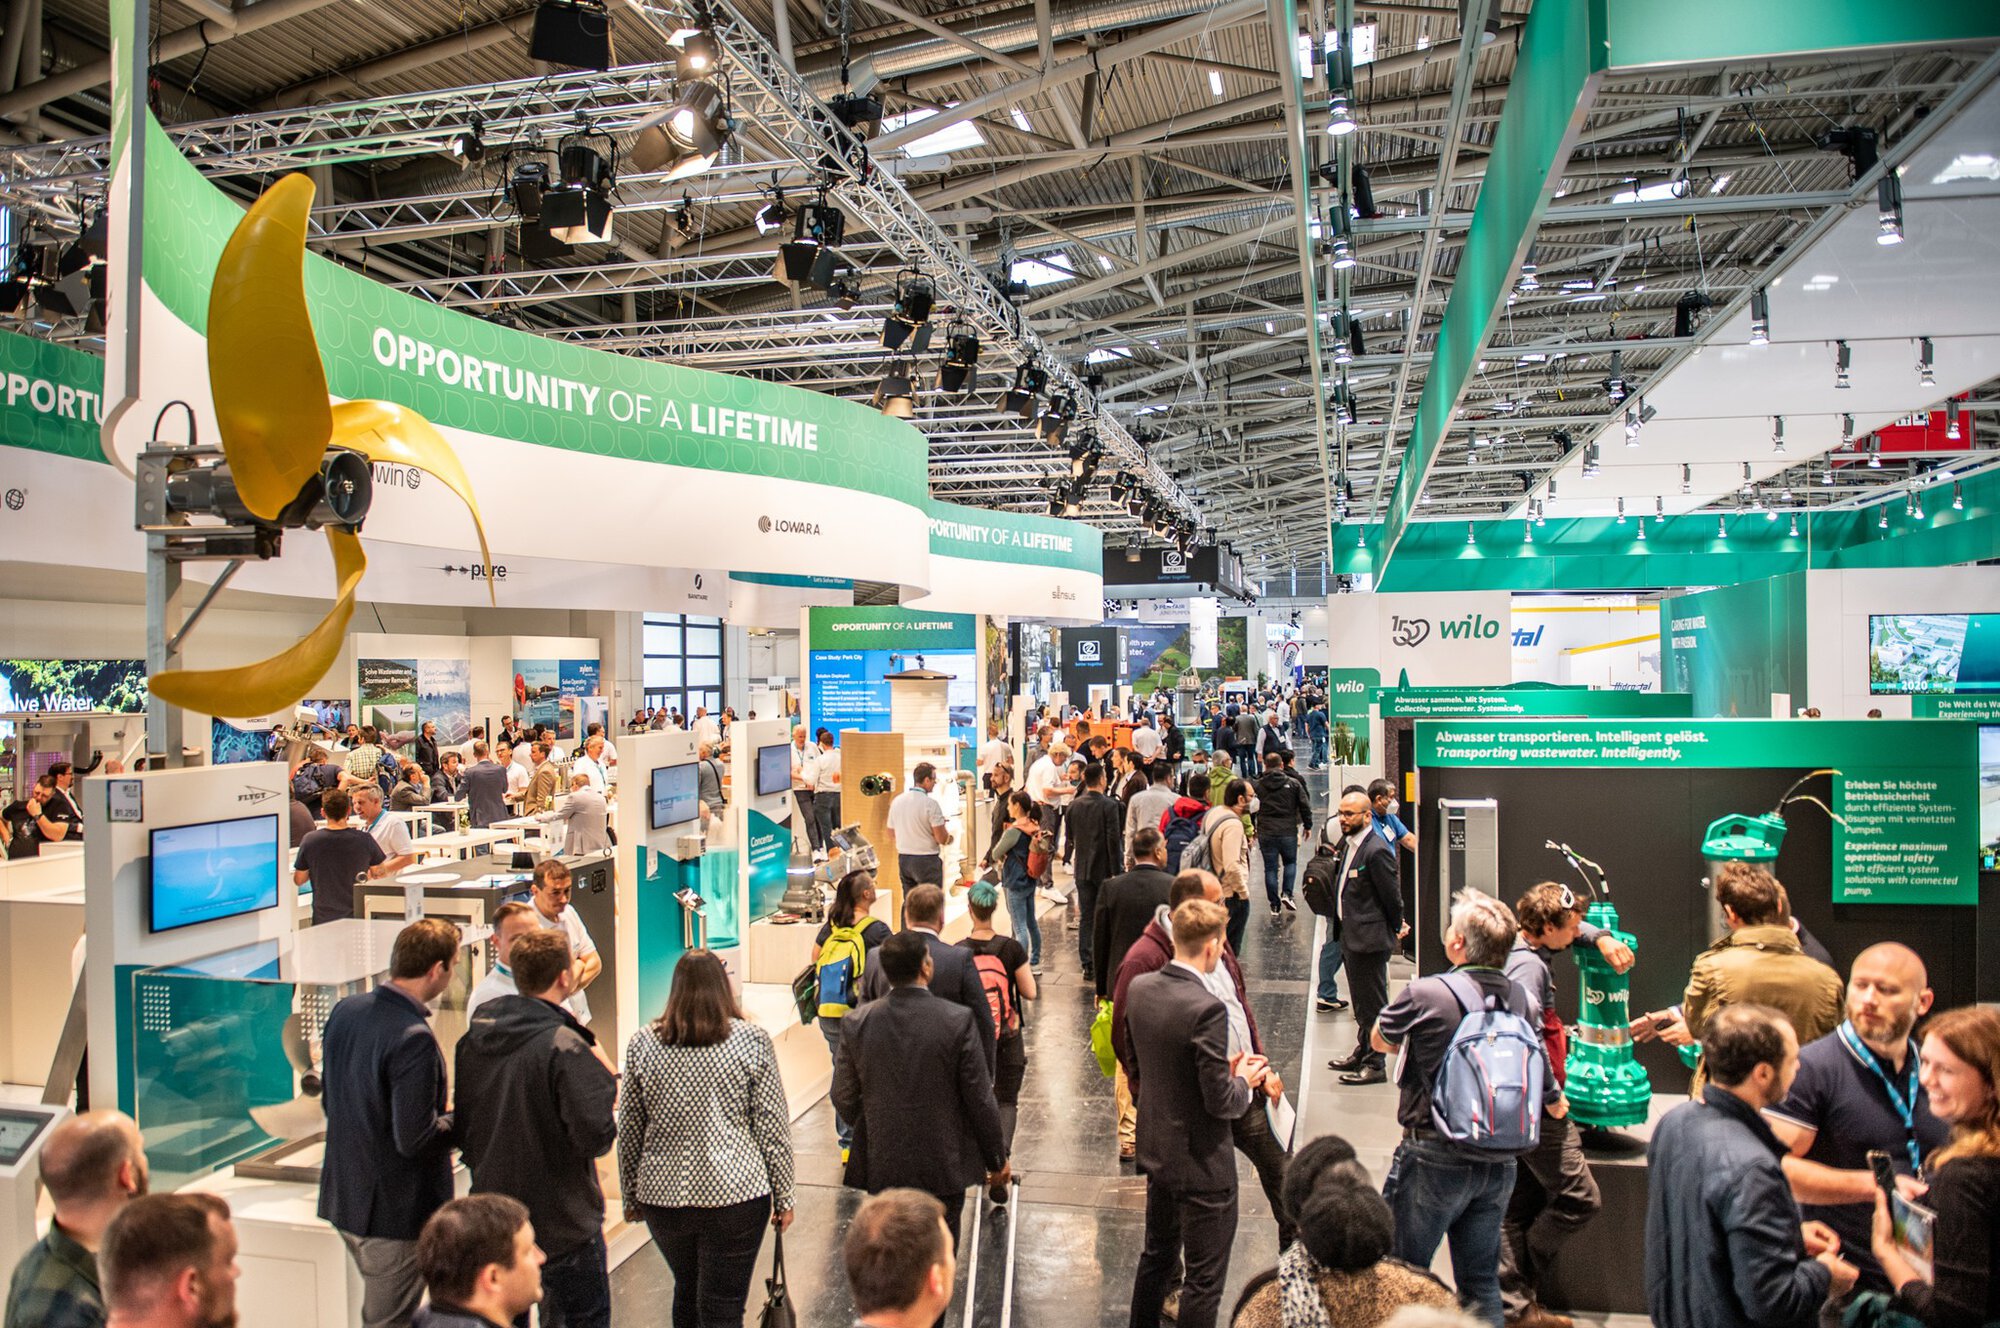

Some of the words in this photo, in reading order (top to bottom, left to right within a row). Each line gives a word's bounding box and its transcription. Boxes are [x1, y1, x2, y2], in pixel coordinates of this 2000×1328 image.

[372, 327, 600, 416] OPPORTUNITY
[608, 390, 652, 424] OF
[660, 400, 683, 430] A
[691, 403, 818, 451] LIFETIME
[372, 462, 404, 487] win
[775, 519, 821, 536] LOWARA
[991, 528, 1009, 545] OF
[1011, 535, 1021, 546] A
[1023, 532, 1072, 553] LIFETIME
[471, 563, 507, 580] pure
[832, 622, 891, 631] OPPORTUNITY
[893, 622, 905, 631] OF
[906, 622, 913, 630] A
[914, 621, 953, 630] LIFETIME
[1440, 614, 1500, 639] wilo
[1511, 624, 1544, 647] tal
[1336, 680, 1364, 693] wilo
[1901, 681, 1928, 690] 2020
[0, 692, 39, 712] olve
[1938, 700, 1952, 708] Die
[1953, 700, 1972, 708] Welt
[1973, 700, 1988, 708] des
[1395, 704, 1430, 713] Collecting
[1938, 710, 1990, 720] Experiencing
[1436, 731, 1495, 743] Abwasser
[1498, 731, 1593, 746] transportieren.
[1596, 731, 1662, 746] Intelligent
[1665, 731, 1709, 745] gelöst.
[1436, 746, 1517, 760] Transporting
[1521, 747, 1598, 758] wastewater.
[1601, 746, 1682, 760] Intelligently.
[1845, 780, 1881, 790] Erleben
[1883, 780, 1897, 790] Sie
[1899, 780, 1937, 790] höchste
[238, 792, 266, 802] FLYGT
[1845, 791, 1930, 801] Betriebssicherheit
[1845, 803, 1870, 812] durch
[1873, 803, 1916, 812] effiziente
[1844, 814, 1886, 825] lösungen
[1888, 814, 1903, 823] mit
[1906, 815, 1955, 823] vernetzten
[1845, 842, 1897, 852] Experience
[1900, 842, 1948, 851] maximum
[1844, 853, 1901, 863] operational
[1903, 853, 1934, 864] safety
[1845, 864, 1865, 873] with
[1867, 864, 1905, 874] efficient
[1907, 866, 1939, 875] system
[1845, 875, 1886, 884] solutions
[1888, 875, 1908, 884] with
[1910, 876, 1958, 885] connected
[1844, 887, 1872, 896] pump.
[1608, 989, 1629, 1002] wil
